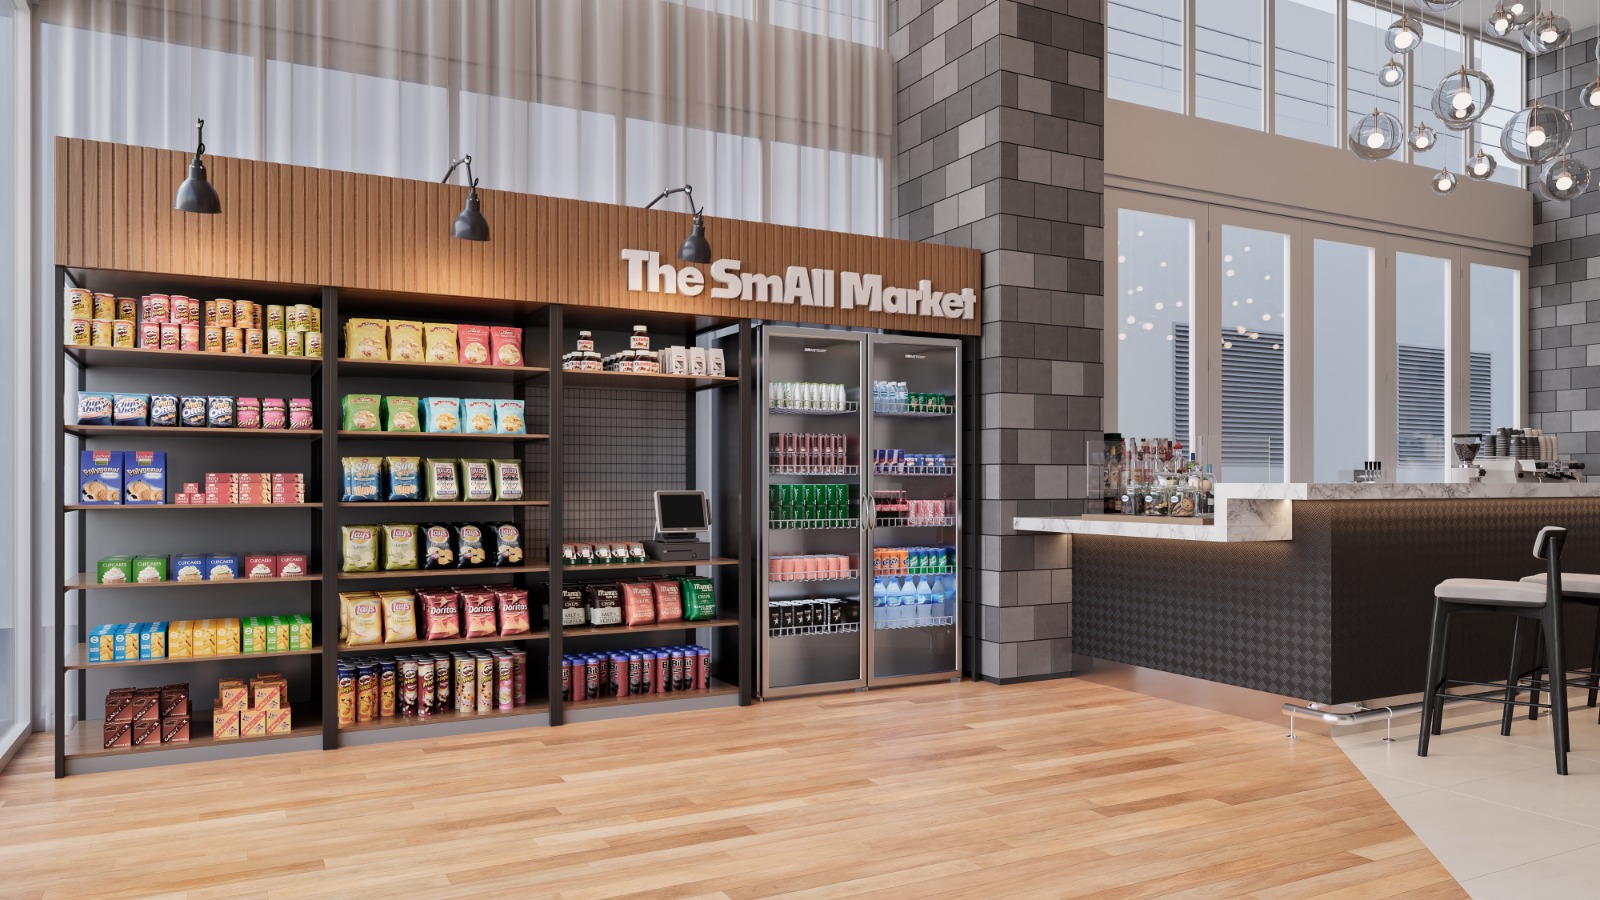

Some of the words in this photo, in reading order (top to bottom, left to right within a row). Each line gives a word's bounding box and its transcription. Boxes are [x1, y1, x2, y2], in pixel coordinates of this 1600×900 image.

[621, 249, 705, 297] The
[710, 258, 834, 308] SmAll
[840, 270, 977, 320] Market
[430, 606, 457, 615] Doritos
[468, 604, 494, 613] Doritos
[502, 603, 528, 612] Doritos
[630, 662, 641, 671] Bit
[671, 659, 683, 667] Bit
[586, 666, 599, 675] Bit
